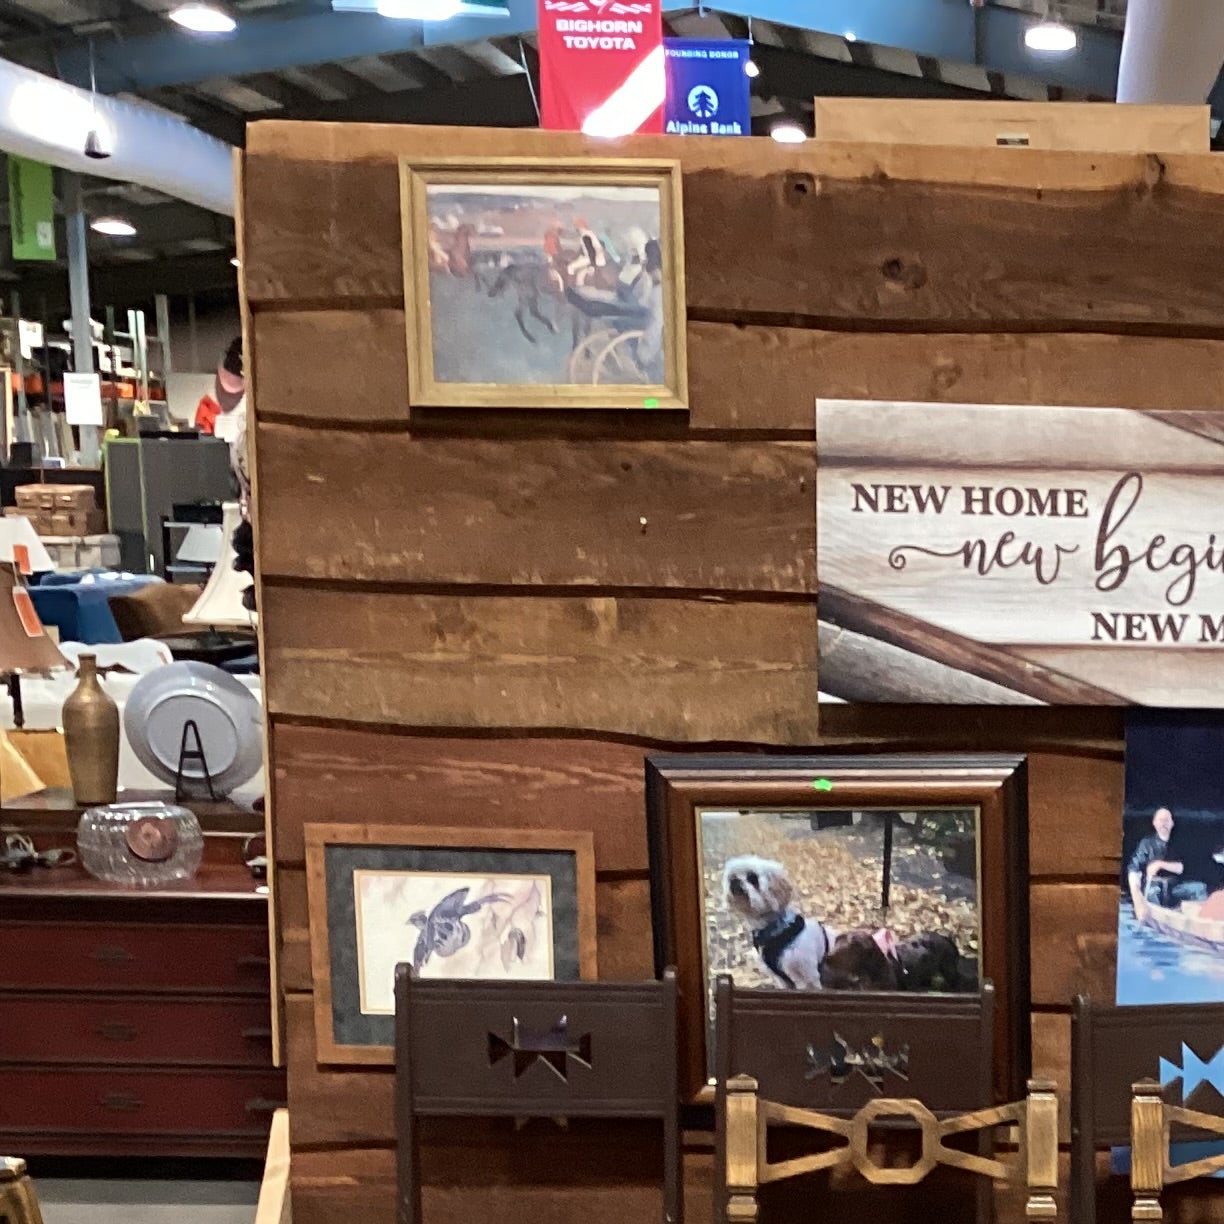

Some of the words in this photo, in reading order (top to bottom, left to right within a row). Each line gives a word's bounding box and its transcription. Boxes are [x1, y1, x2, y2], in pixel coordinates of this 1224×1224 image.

[556, 19, 643, 34] BIGHORN
[563, 36, 636, 50] TOYOTA
[709, 50, 739, 59] DONOR
[666, 120, 707, 135] Alpine
[710, 121, 741, 135] Bank
[851, 484, 951, 513] NEW
[961, 486, 1089, 517] HOME
[915, 531, 1080, 585] new
[1091, 612, 1190, 641] NEW
